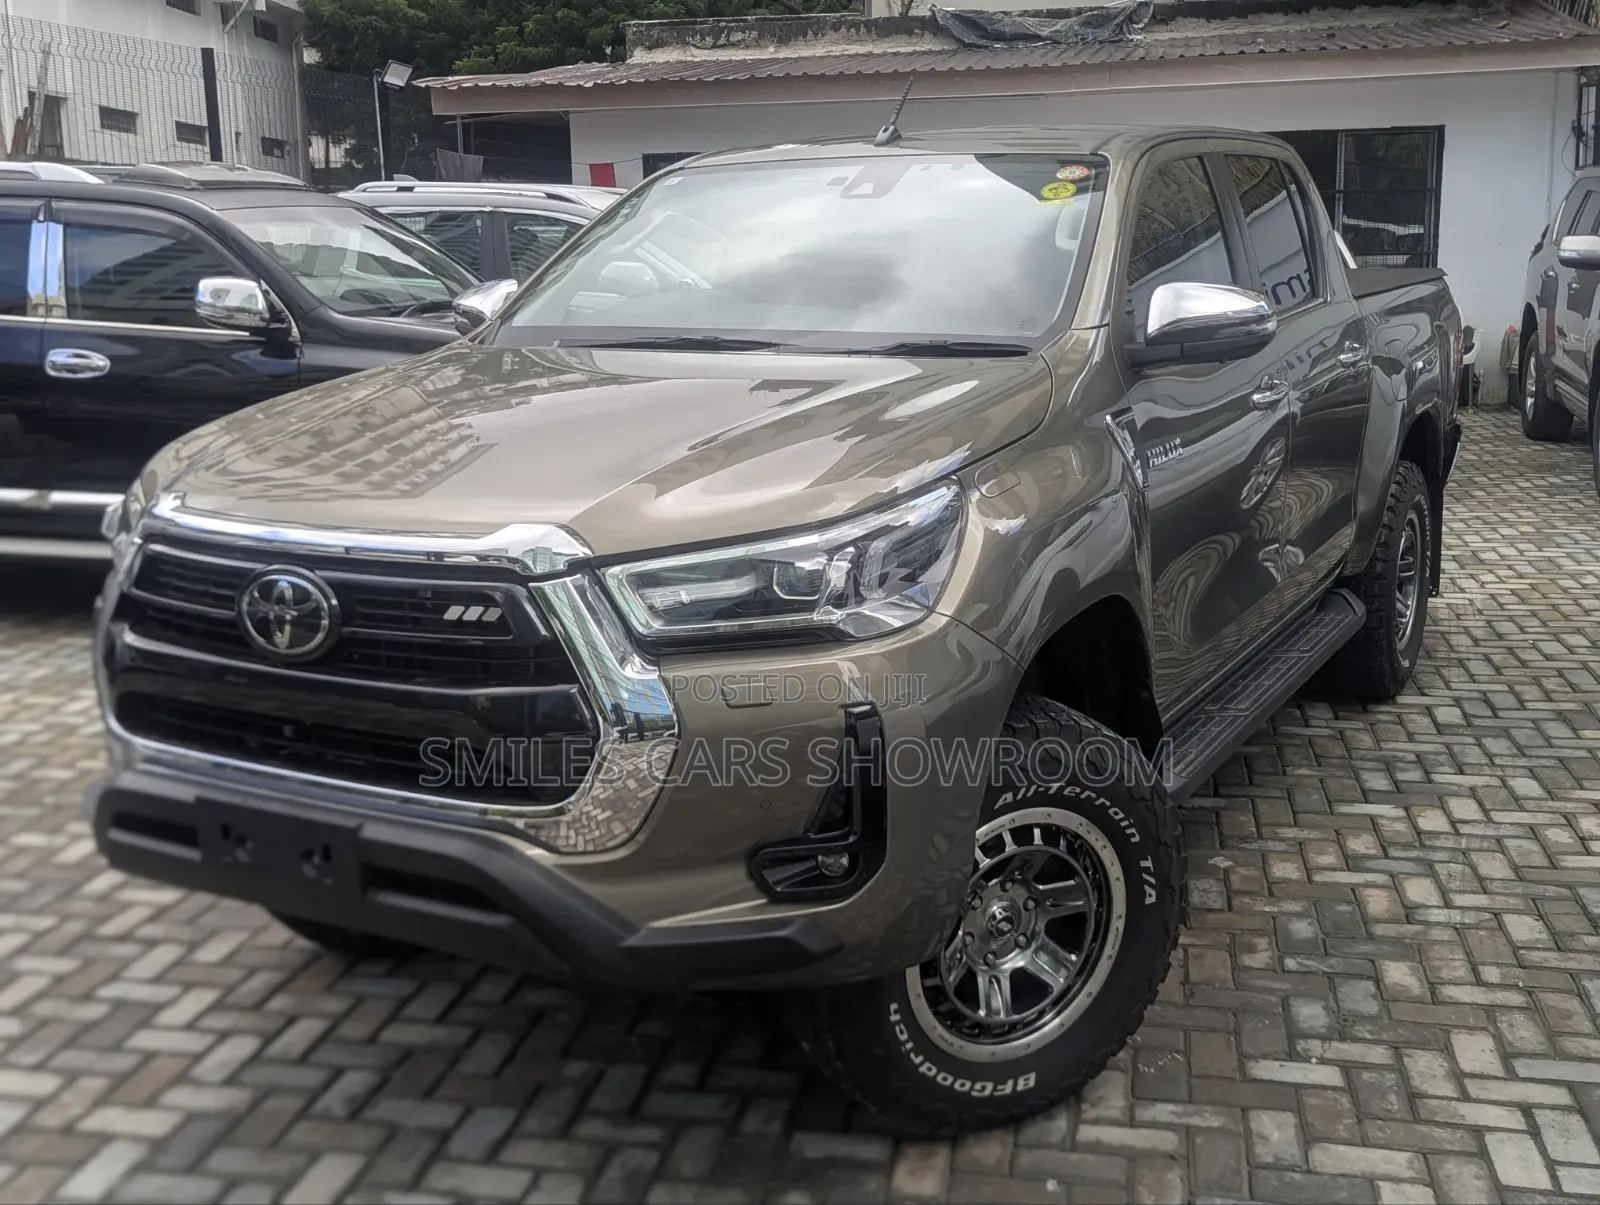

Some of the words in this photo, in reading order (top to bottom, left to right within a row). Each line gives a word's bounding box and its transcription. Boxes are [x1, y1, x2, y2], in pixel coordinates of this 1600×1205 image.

[993, 782, 1141, 843] All-Terrain
[1139, 855, 1158, 905] T/A
[889, 1002, 1037, 1097] BFGoodrich
